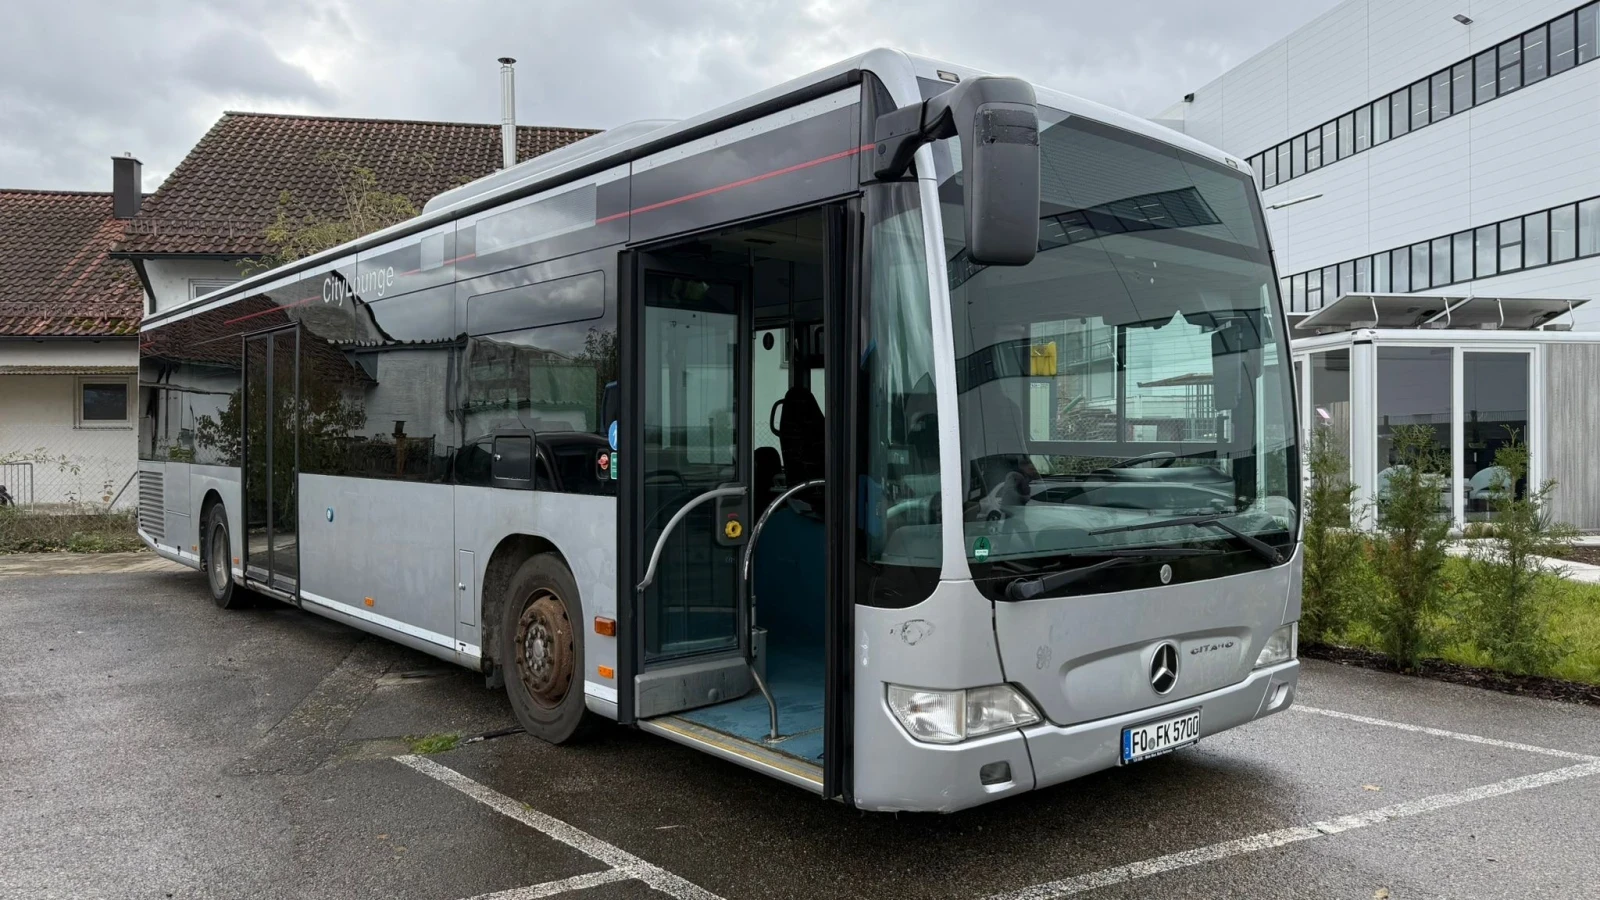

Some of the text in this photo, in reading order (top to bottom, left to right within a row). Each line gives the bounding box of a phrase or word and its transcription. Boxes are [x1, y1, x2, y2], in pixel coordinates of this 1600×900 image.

[323, 266, 394, 306] CityLounge
[980, 537, 985, 550] 4
[1132, 729, 1148, 754] FO
[1156, 723, 1171, 747] FK
[1173, 715, 1199, 742] 5700
